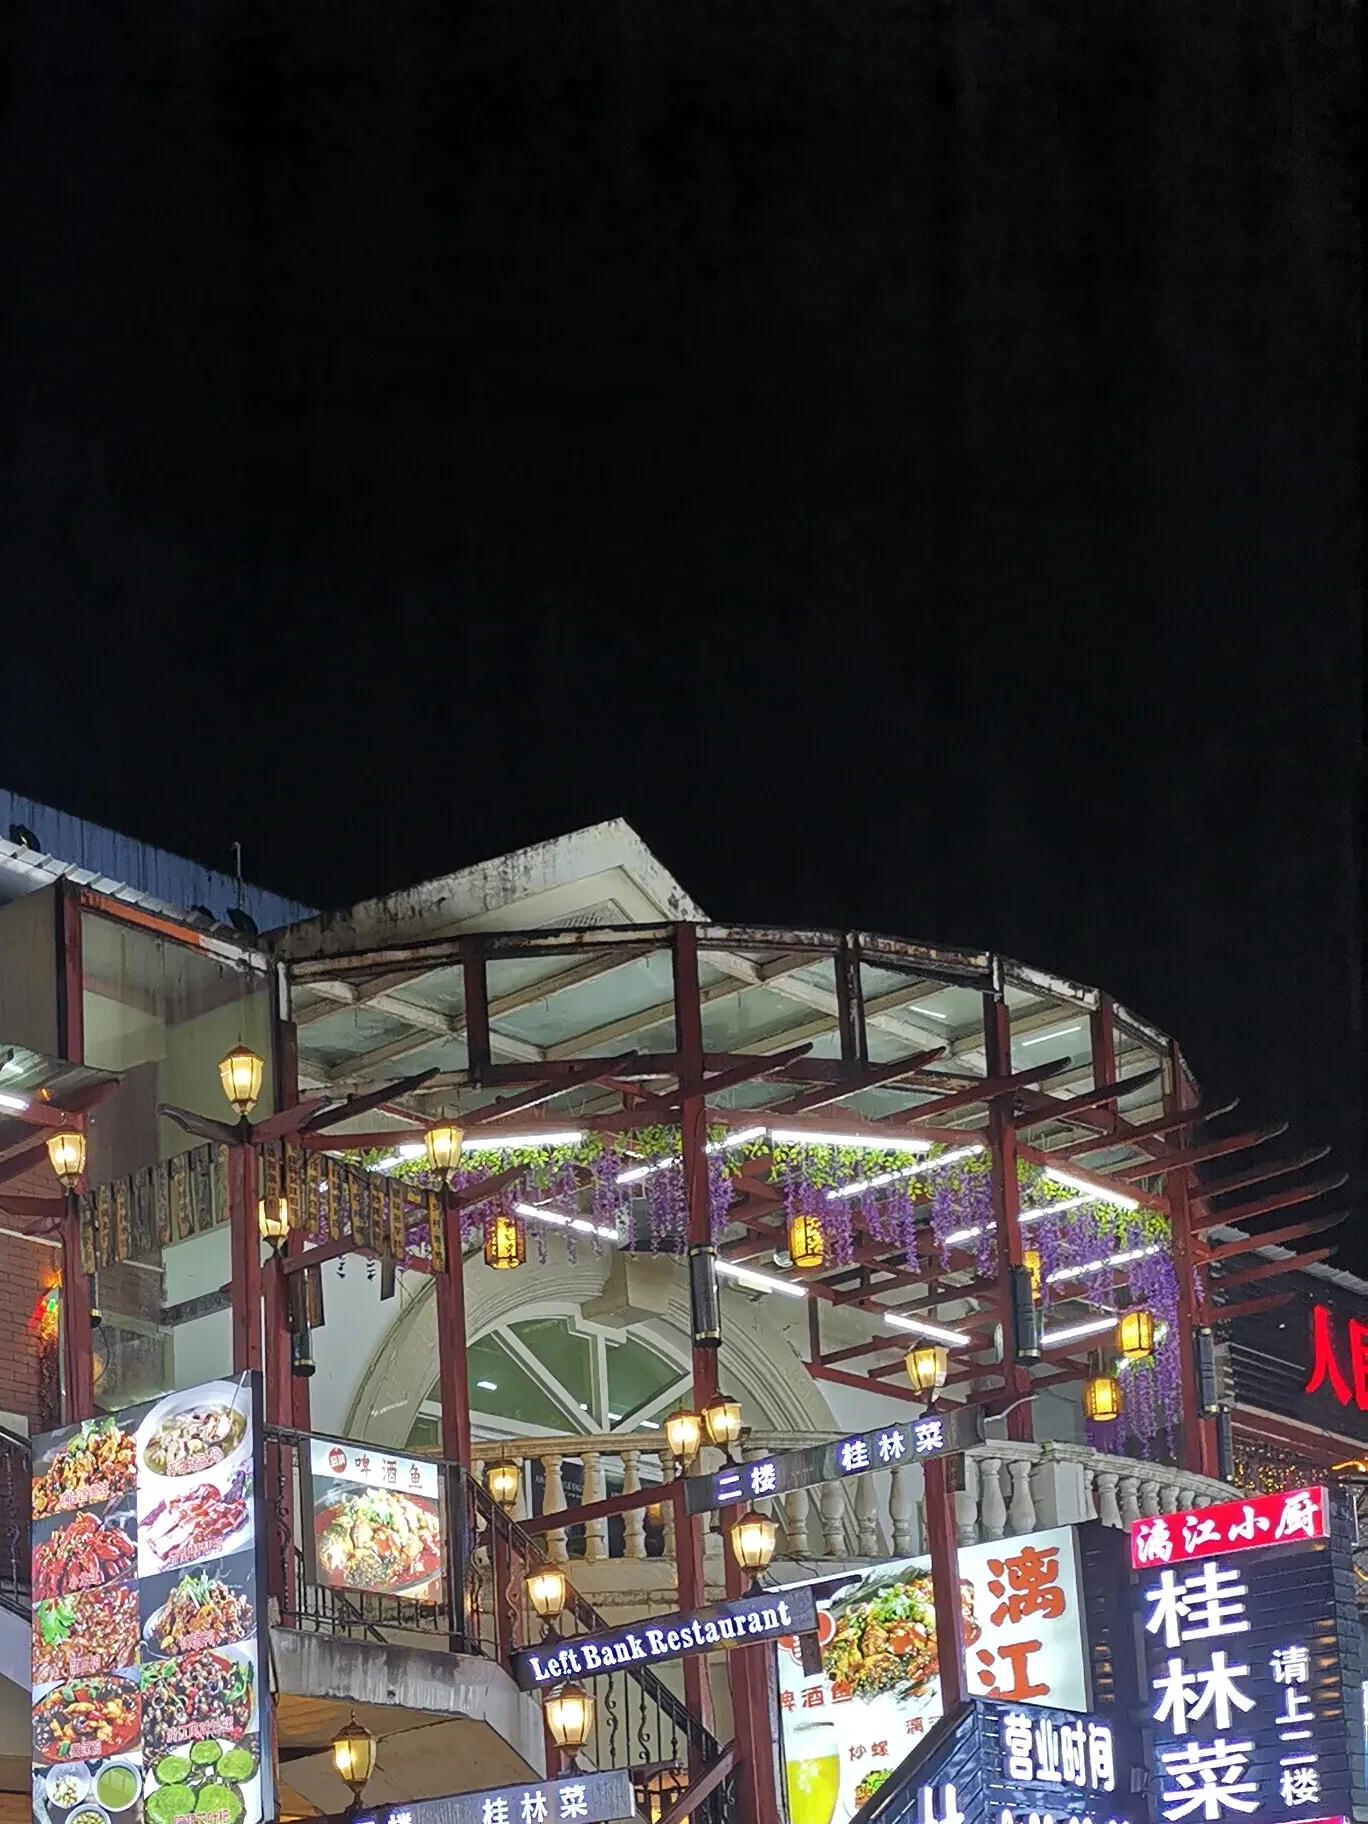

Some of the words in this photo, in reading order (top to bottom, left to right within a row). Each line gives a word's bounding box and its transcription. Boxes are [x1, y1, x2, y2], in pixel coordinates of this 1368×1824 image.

[354, 1454, 421, 1483] 啤酒鱼
[717, 1464, 778, 1502] 二楼
[842, 1421, 945, 1473] 桂林菜
[1136, 1492, 1322, 1565] 漓江小厨
[529, 1642, 581, 1682] Left
[584, 1632, 646, 1674] Bank
[647, 1599, 792, 1658] Restaurant
[975, 1546, 1066, 1701] 漓江
[1145, 1561, 1261, 1822] 桂林菜
[1270, 1644, 1321, 1808] 请上二楼
[1003, 1712, 1115, 1794] 营业时间
